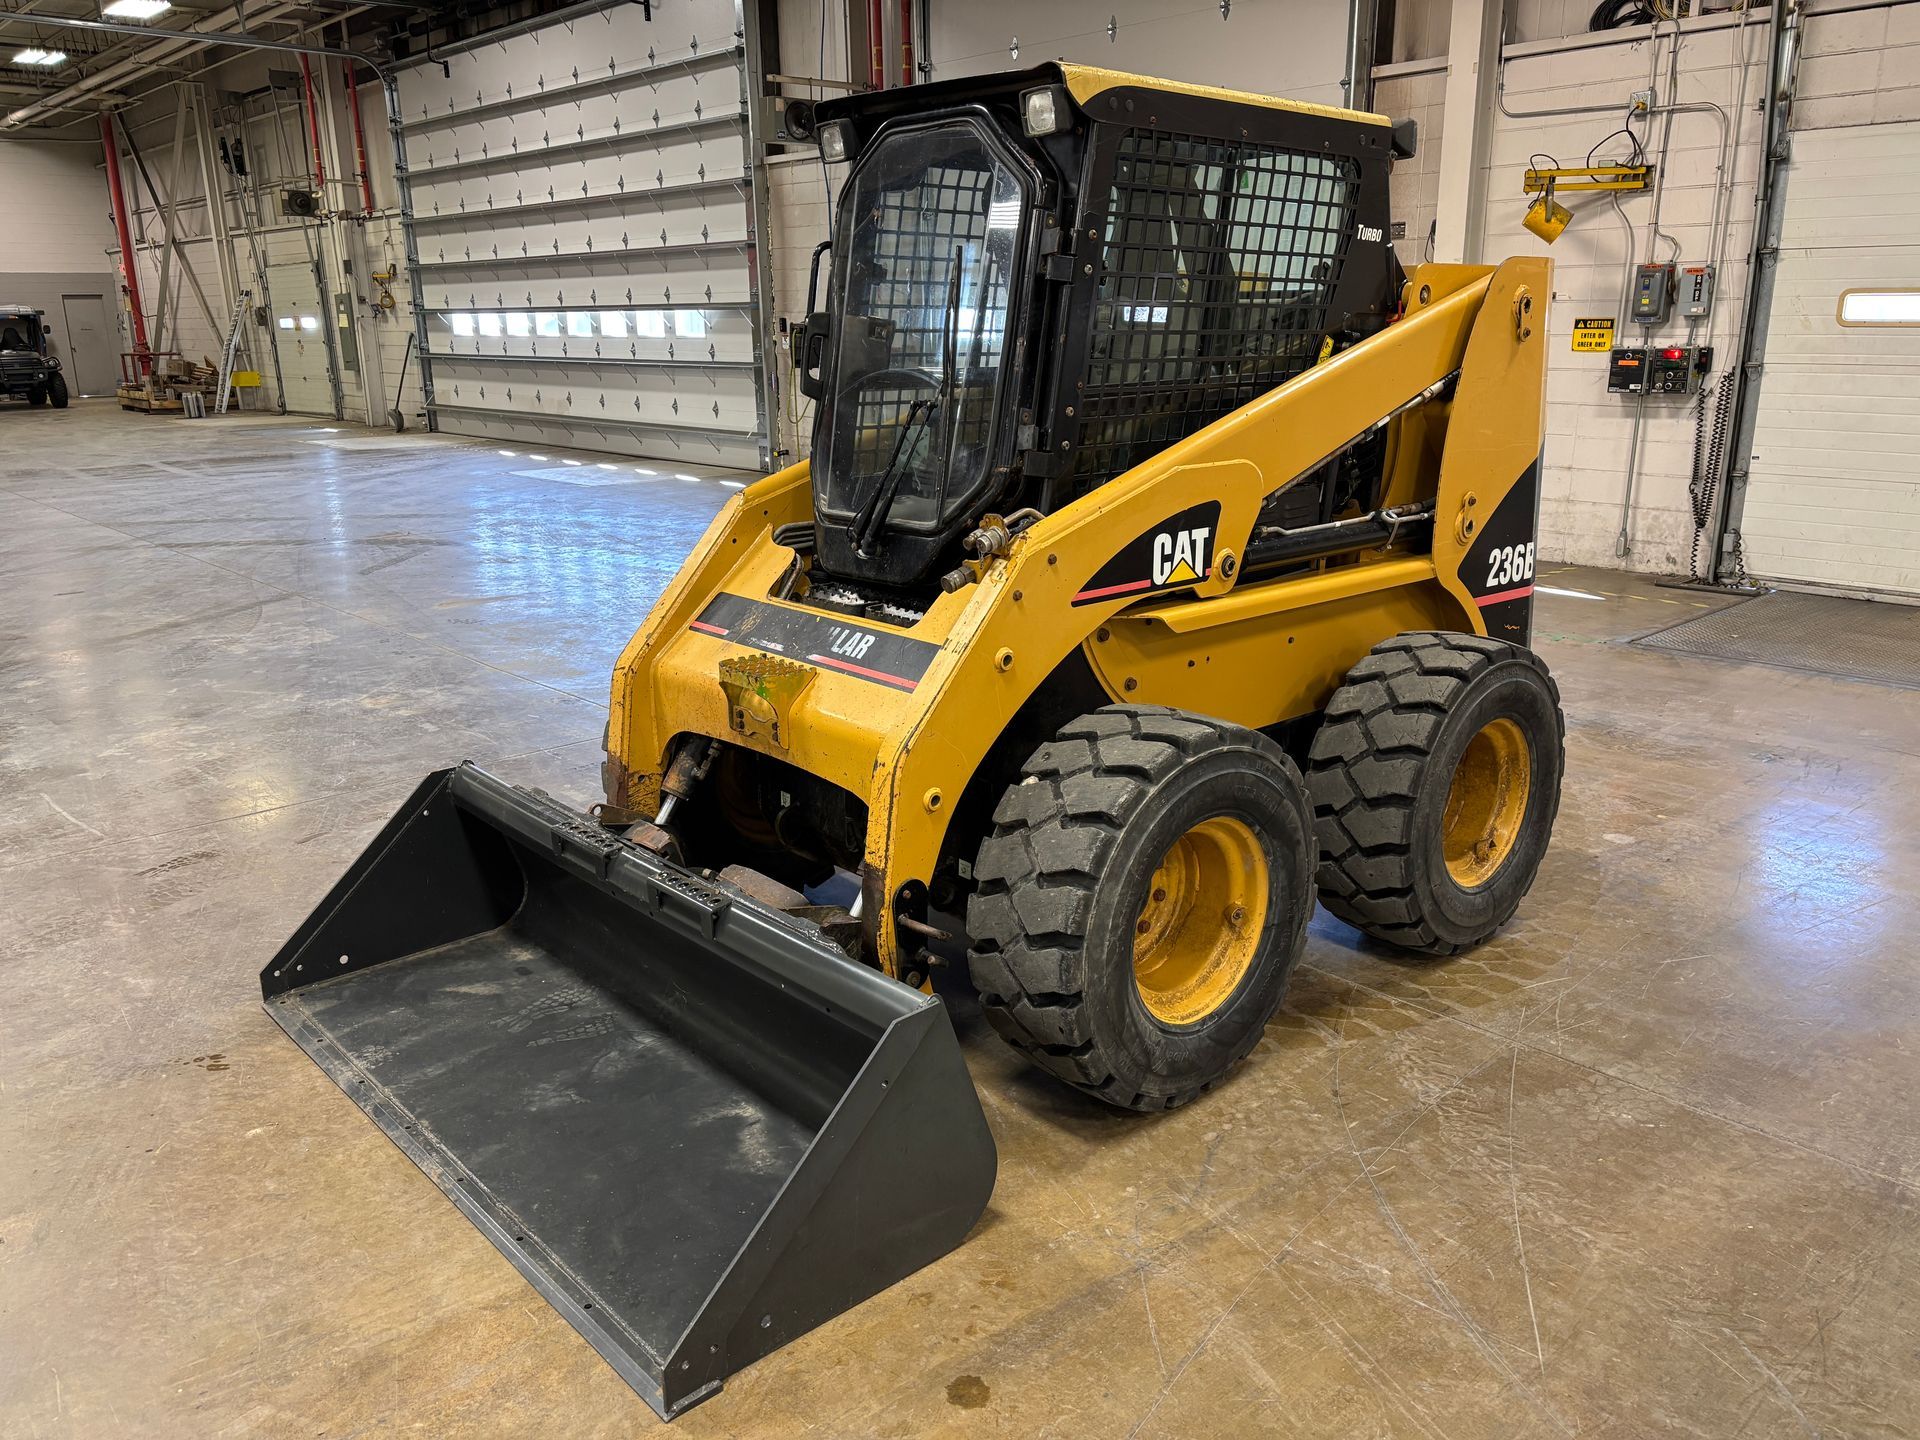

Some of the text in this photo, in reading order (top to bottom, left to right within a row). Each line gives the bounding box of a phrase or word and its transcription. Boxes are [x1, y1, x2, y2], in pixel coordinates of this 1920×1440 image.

[1586, 320, 1612, 328] CAUTION
[1153, 527, 1210, 586] CAT
[1486, 541, 1535, 588] 236B
[828, 626, 876, 660] LAR
